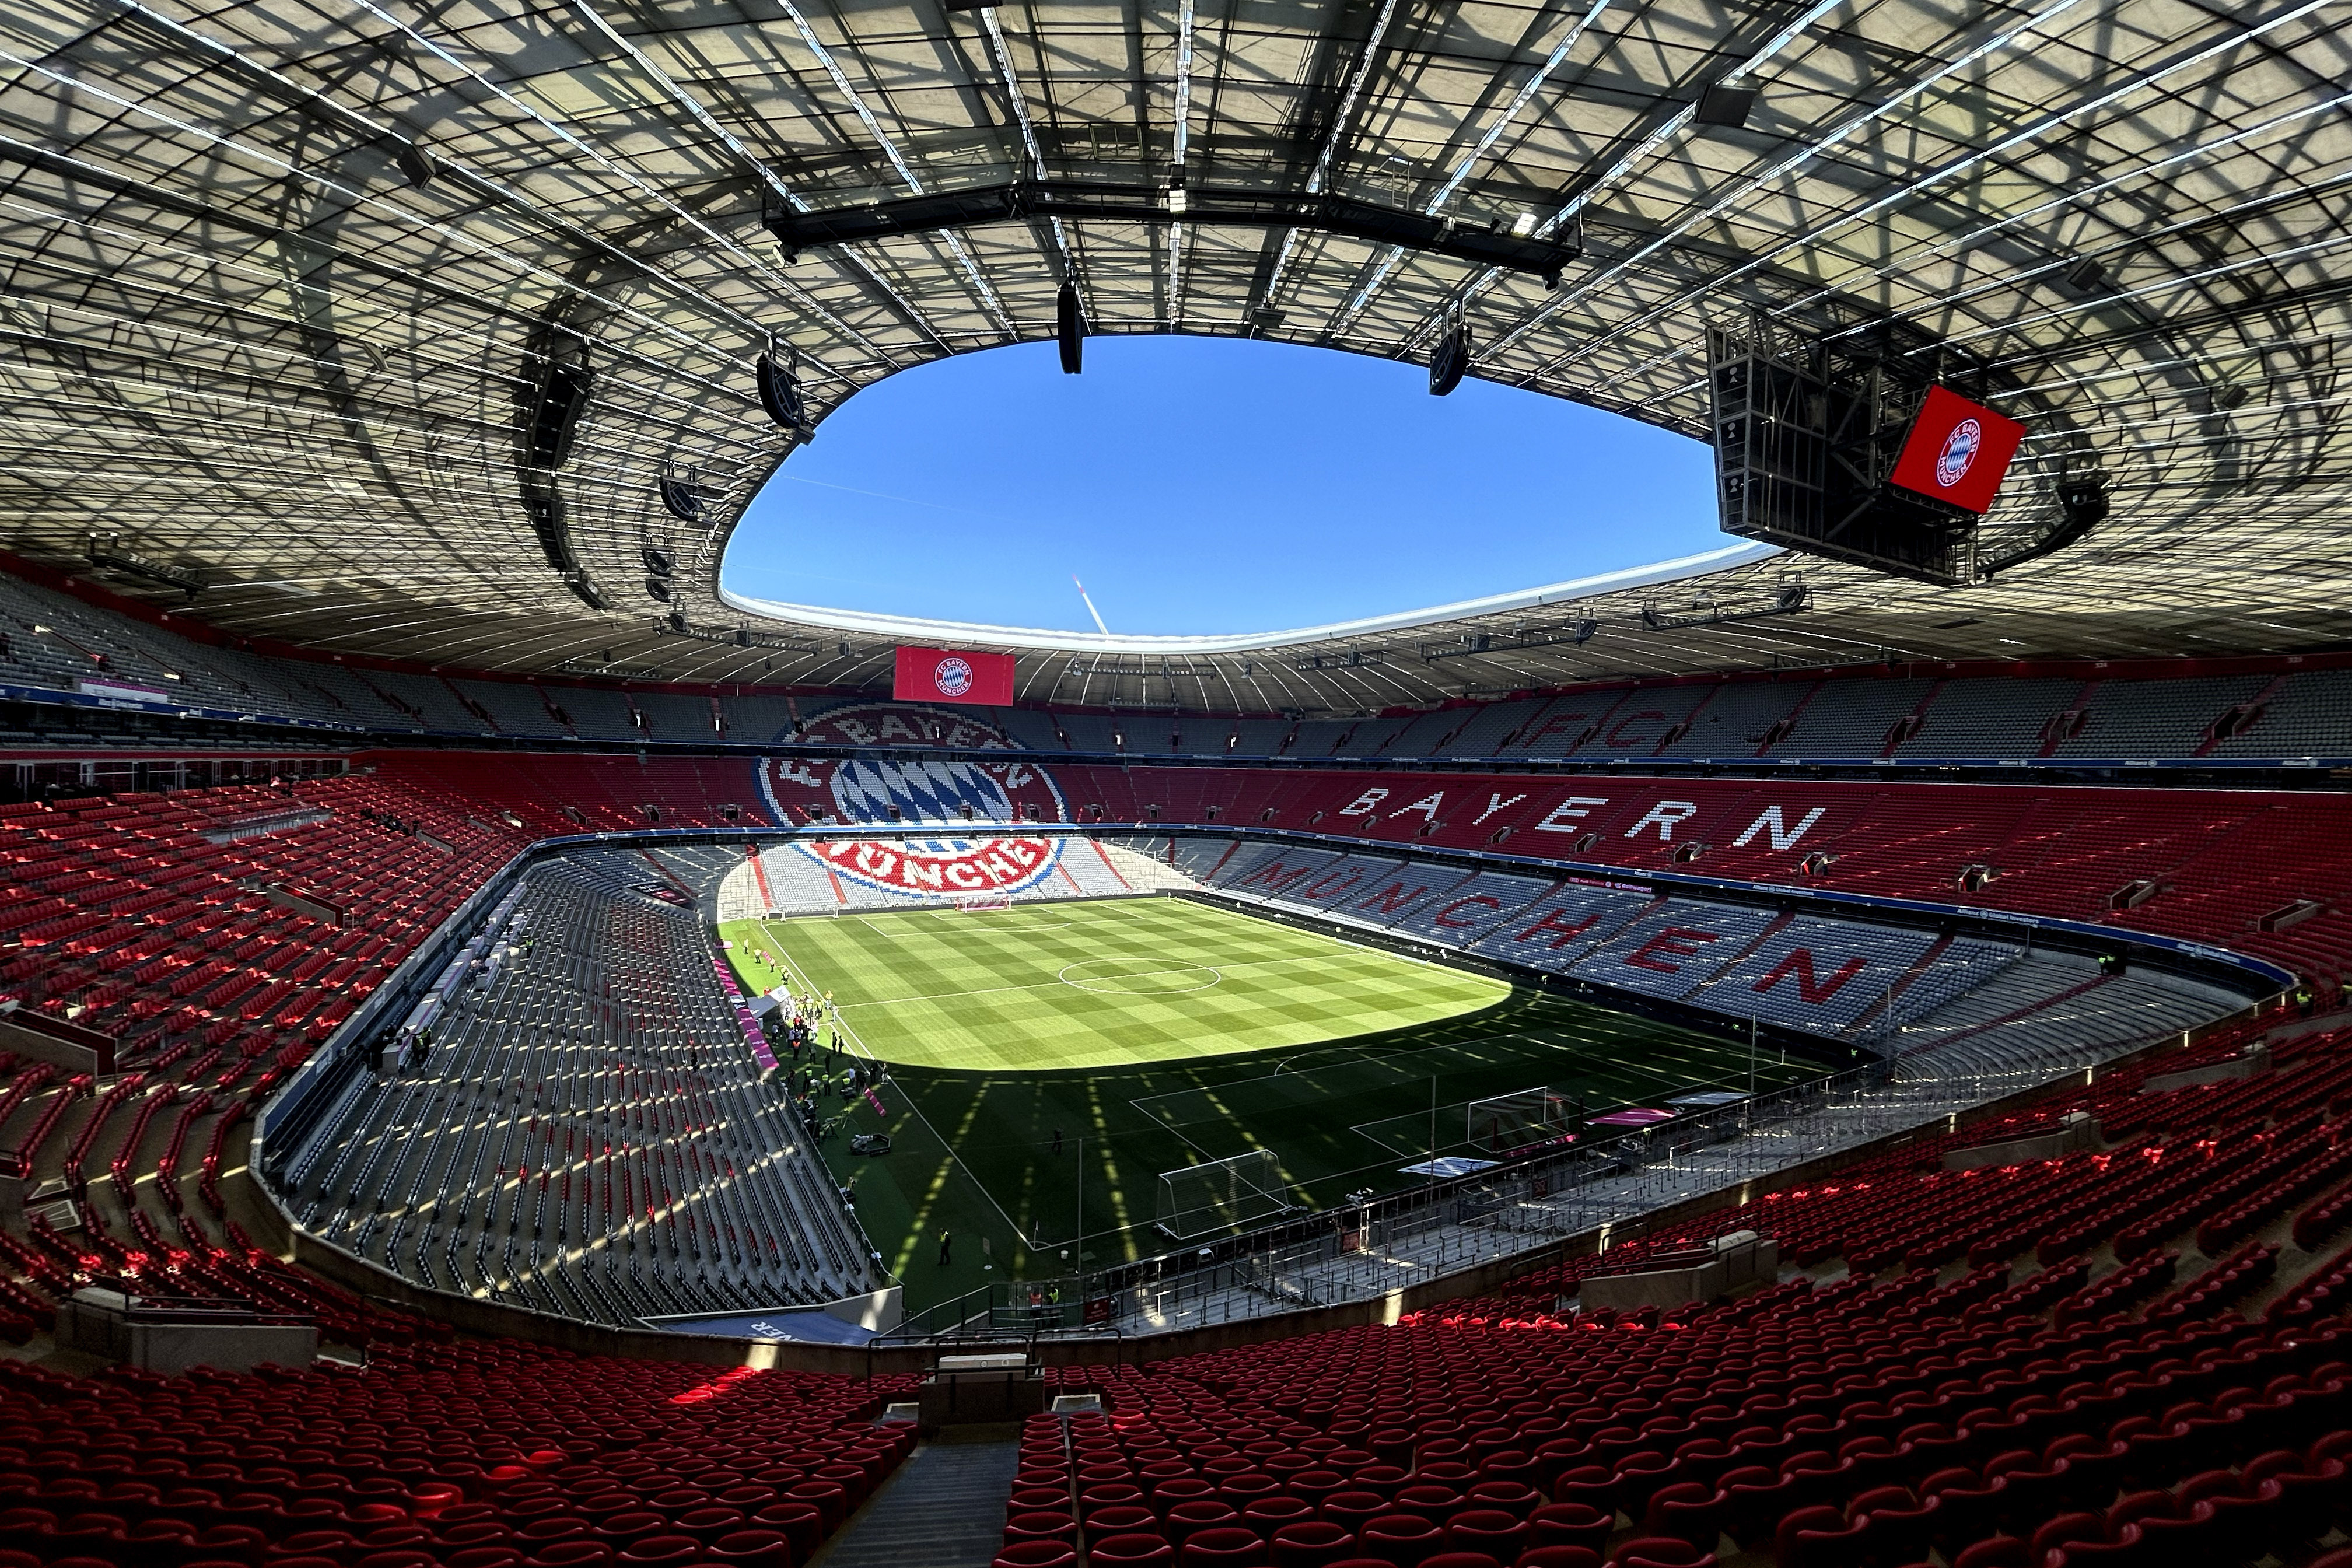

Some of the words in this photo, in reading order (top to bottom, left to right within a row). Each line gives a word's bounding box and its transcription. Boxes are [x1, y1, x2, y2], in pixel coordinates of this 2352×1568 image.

[1949, 429, 1961, 444] FC
[1962, 424, 1979, 453] BAYERN
[938, 664, 946, 674] FC
[946, 660, 970, 676] BAYERN
[1522, 710, 1665, 749] FC
[1339, 788, 1826, 851] BAYERN
[1241, 862, 1867, 1005] MÜNCHEN
[2010, 915, 2039, 924] Investors
[751, 1321, 803, 1342] VER
